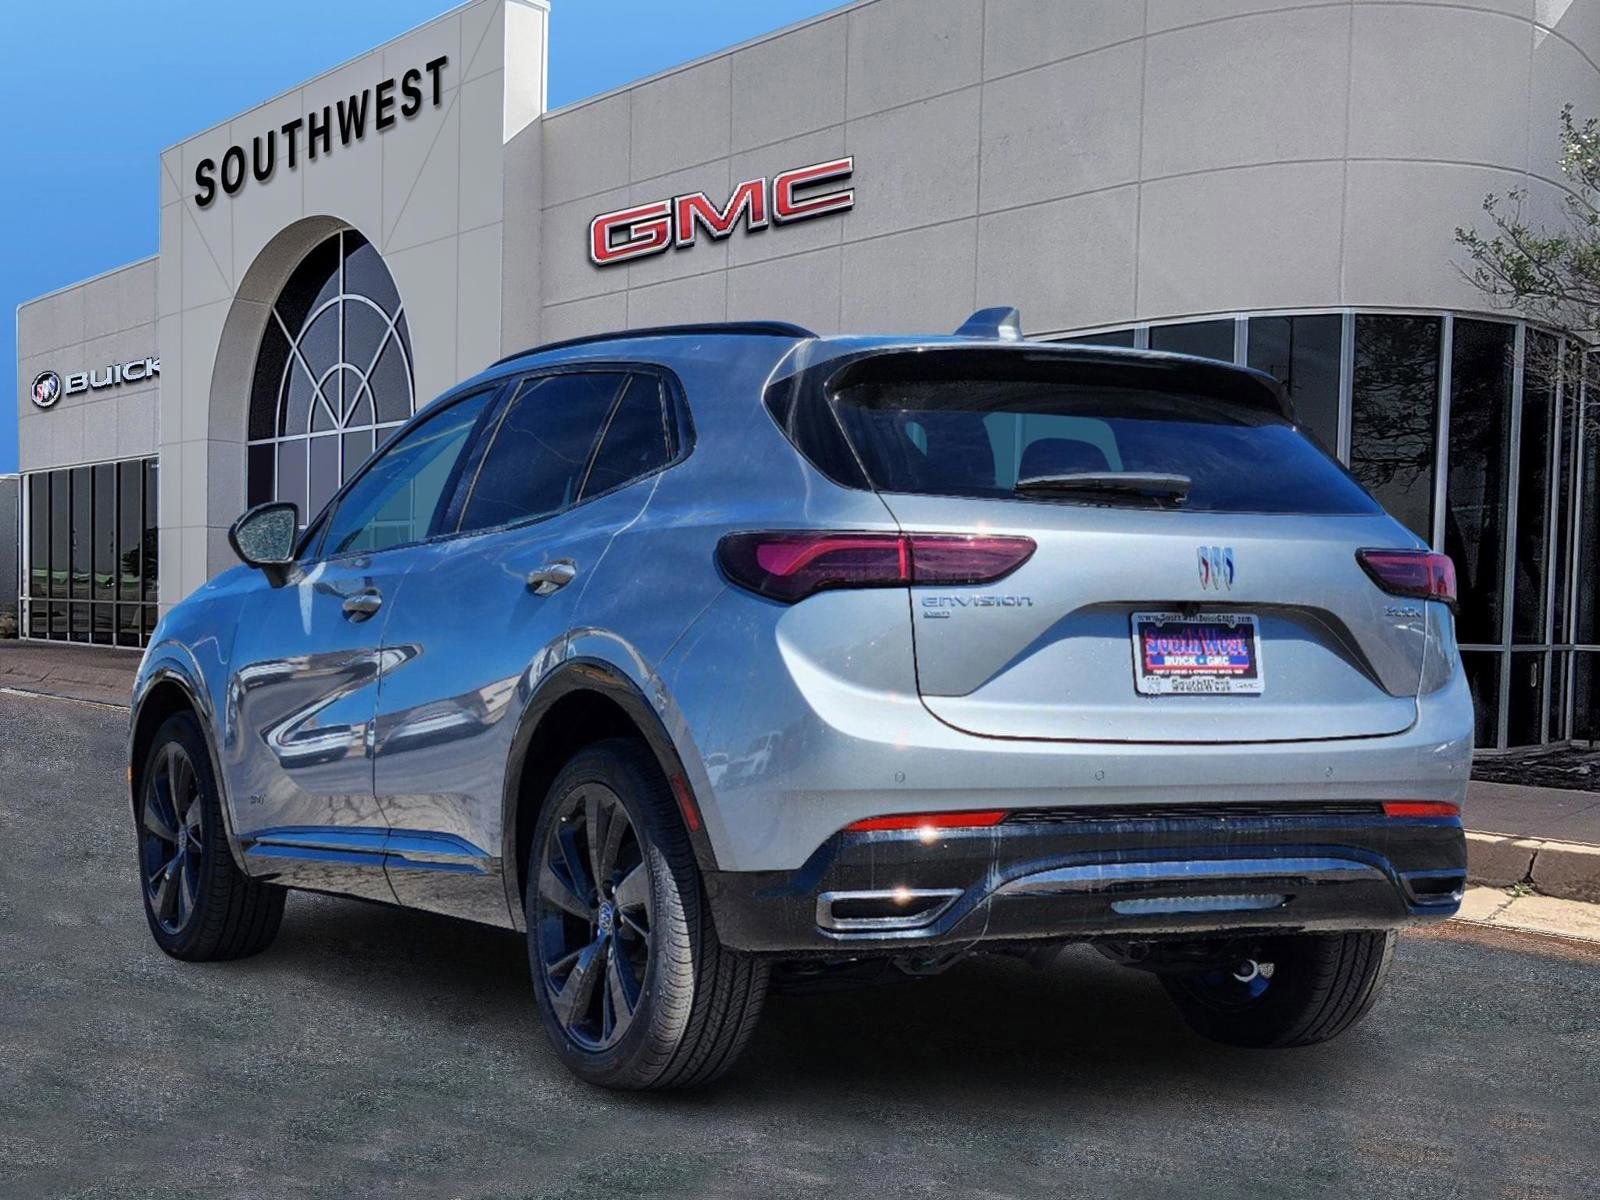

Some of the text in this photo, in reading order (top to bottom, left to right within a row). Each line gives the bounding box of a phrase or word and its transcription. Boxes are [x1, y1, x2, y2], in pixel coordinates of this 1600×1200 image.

[194, 55, 448, 208] SOUTHWEST
[589, 156, 855, 266] GMC
[65, 356, 161, 395] BUICK
[1164, 655, 1196, 665] BUICK
